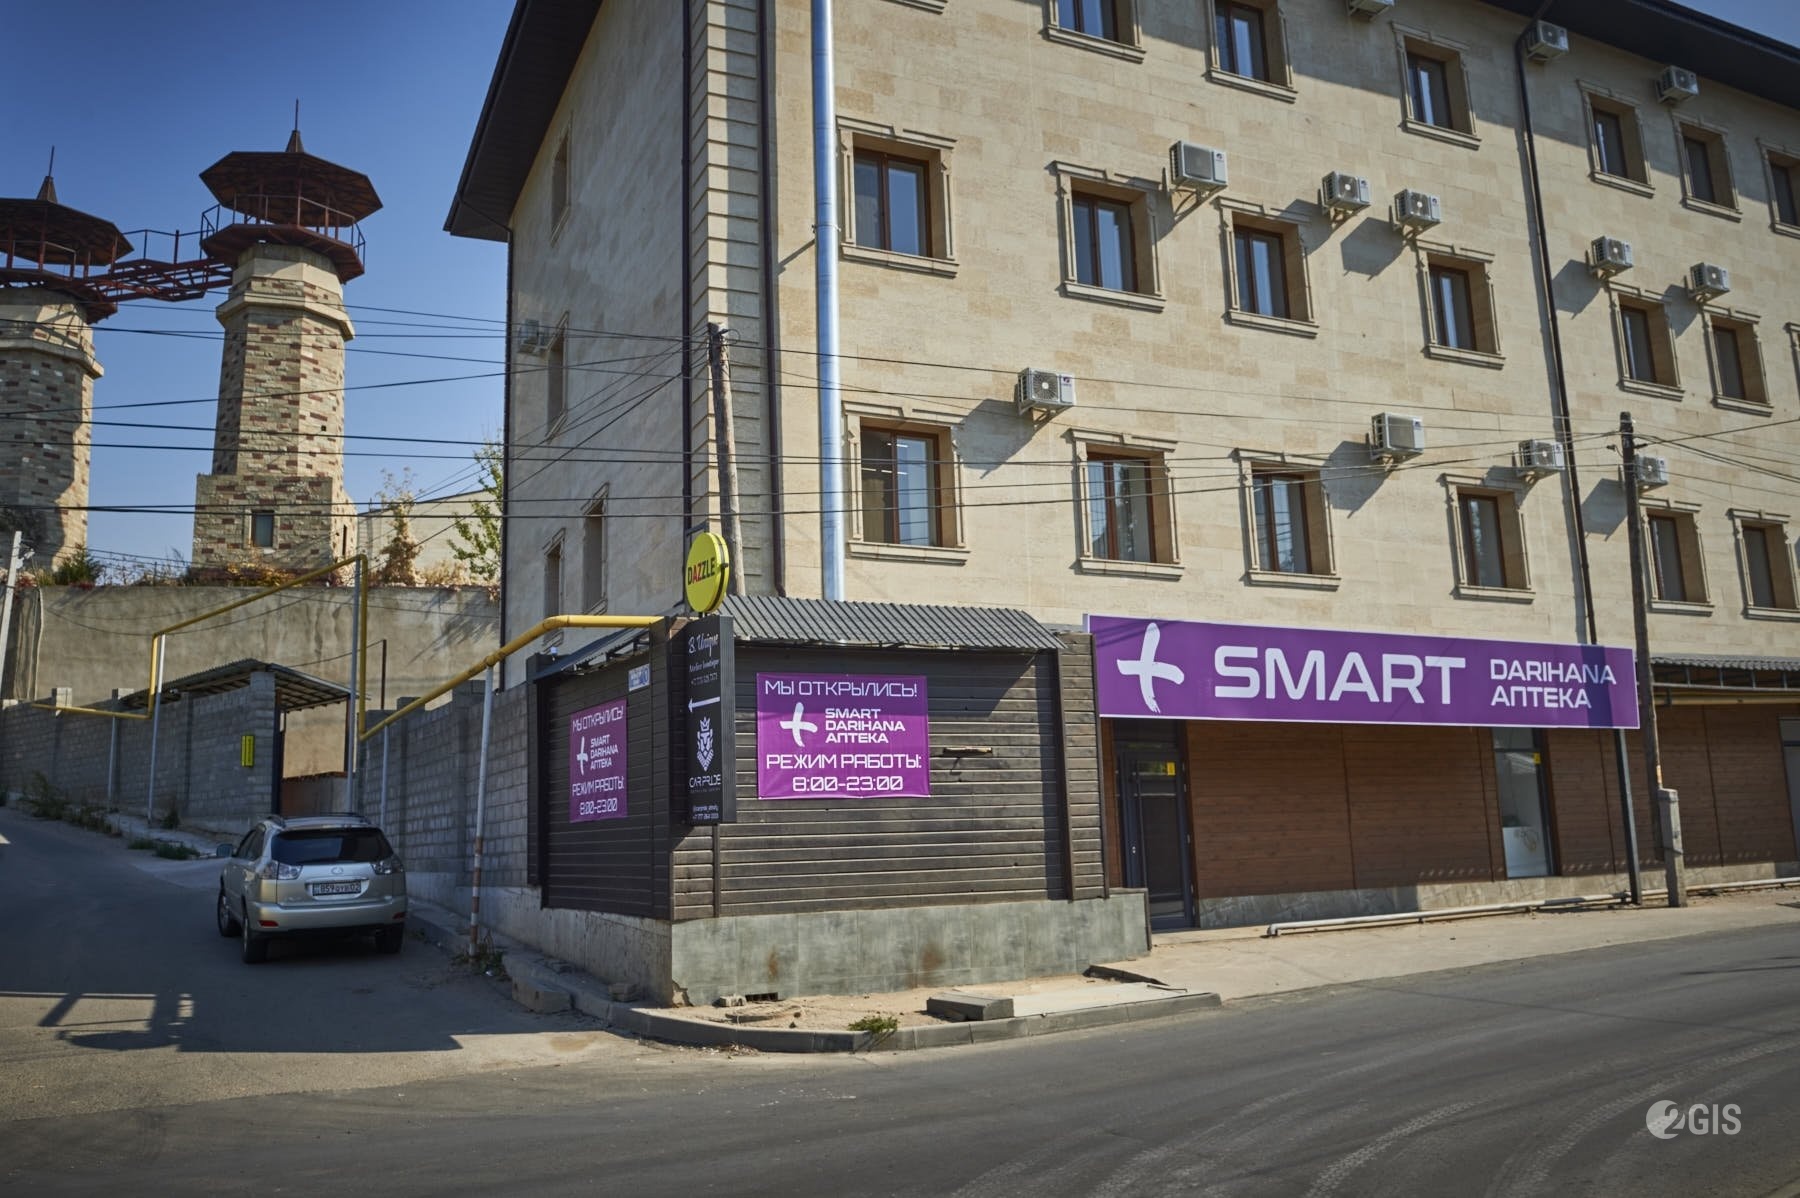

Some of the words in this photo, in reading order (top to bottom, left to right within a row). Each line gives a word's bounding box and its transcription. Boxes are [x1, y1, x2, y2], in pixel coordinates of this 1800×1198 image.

[688, 557, 715, 585] DAZZLE
[1214, 645, 1466, 704] SMART
[1490, 659, 1617, 685] DARIHANA
[765, 680, 795, 695] МЫ
[799, 681, 917, 697] ОТКРЫЛИСЬ!
[1490, 686, 1592, 709] АПТЕКА
[825, 708, 881, 719] SMART
[572, 719, 582, 733] МЫ
[825, 720, 905, 731] DARIHANA
[590, 734, 610, 748] SMART
[825, 733, 889, 743] АПТЕКА
[590, 744, 618, 759] DARIHANA
[590, 757, 612, 770] АПТЕКА
[766, 754, 837, 769] РЕЖИМ
[841, 754, 922, 769] РАБОТЫ:
[572, 781, 594, 797] РЕЖИМ
[792, 776, 904, 791] 8:00-23:00
